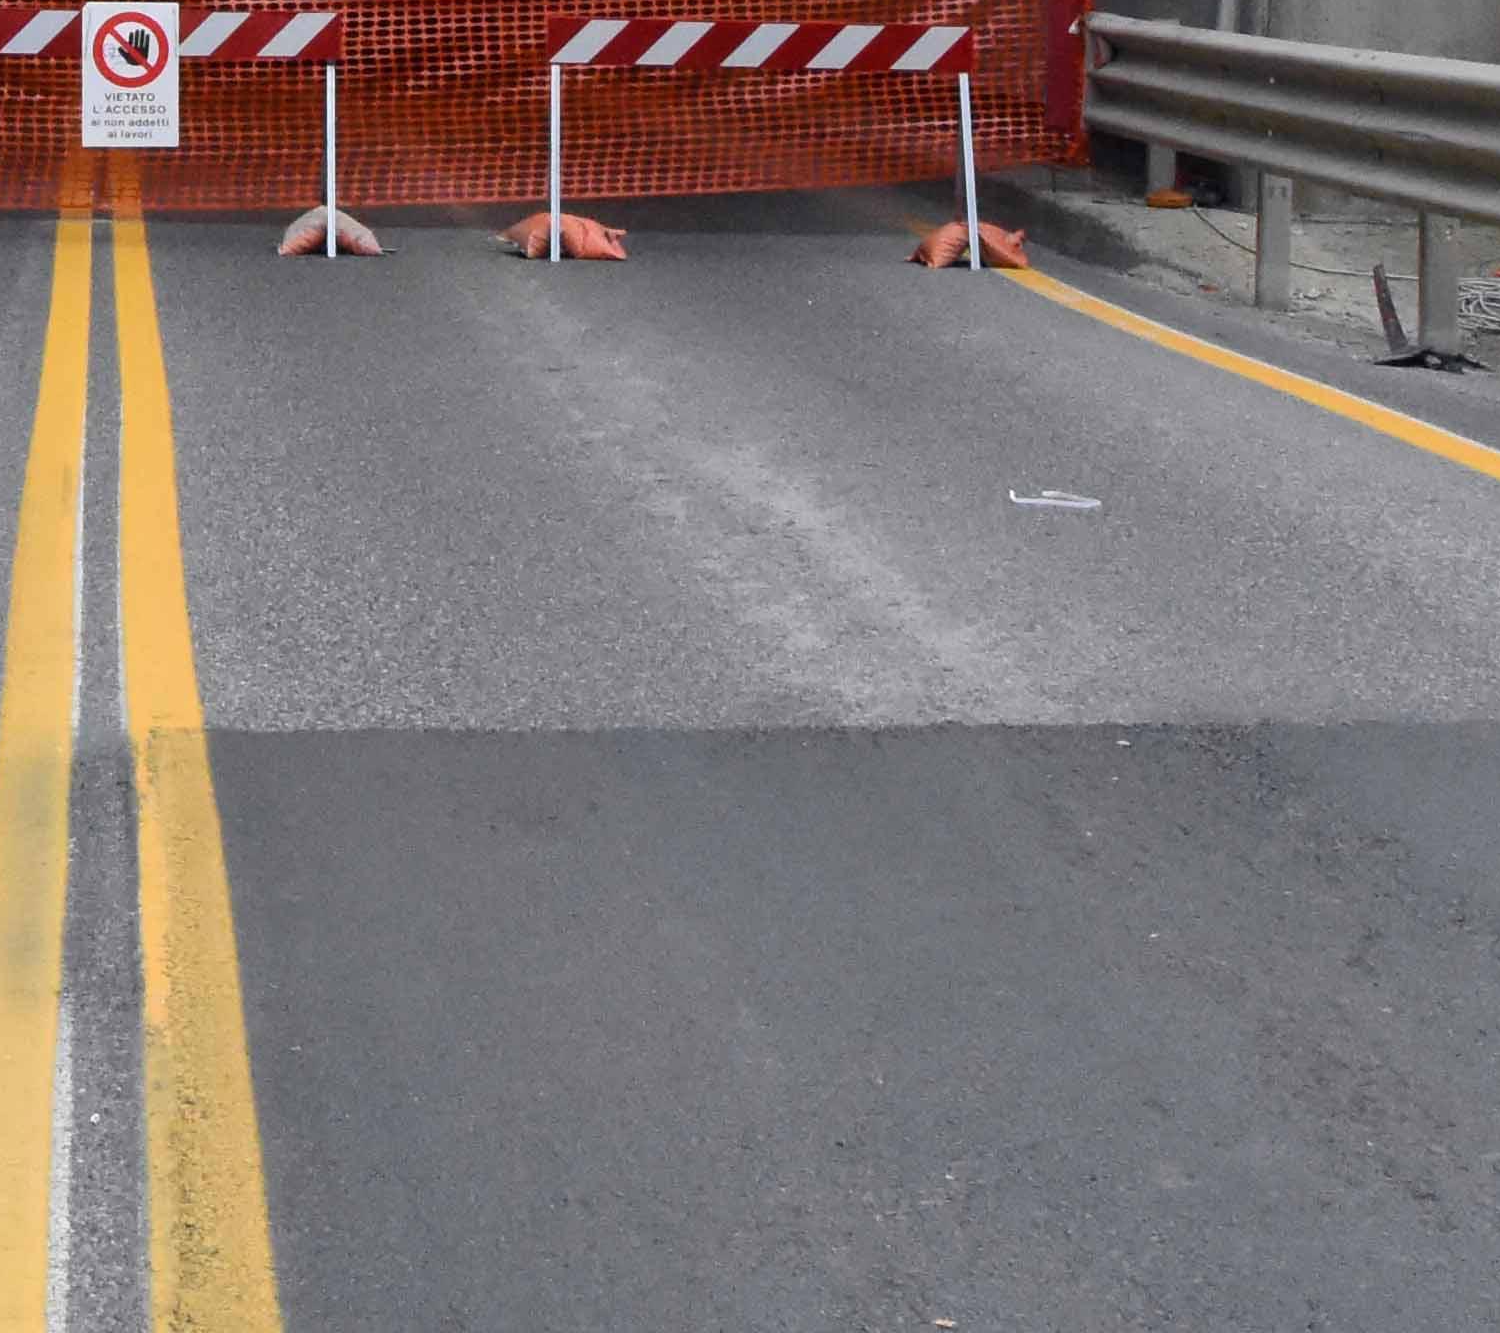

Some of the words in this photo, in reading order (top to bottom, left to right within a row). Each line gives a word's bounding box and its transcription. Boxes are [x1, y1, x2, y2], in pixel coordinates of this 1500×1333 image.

[104, 92, 156, 102] VIETATO
[104, 119, 125, 127] non
[128, 117, 170, 127] addetti
[107, 130, 117, 139] ai
[120, 130, 152, 139] lavori
